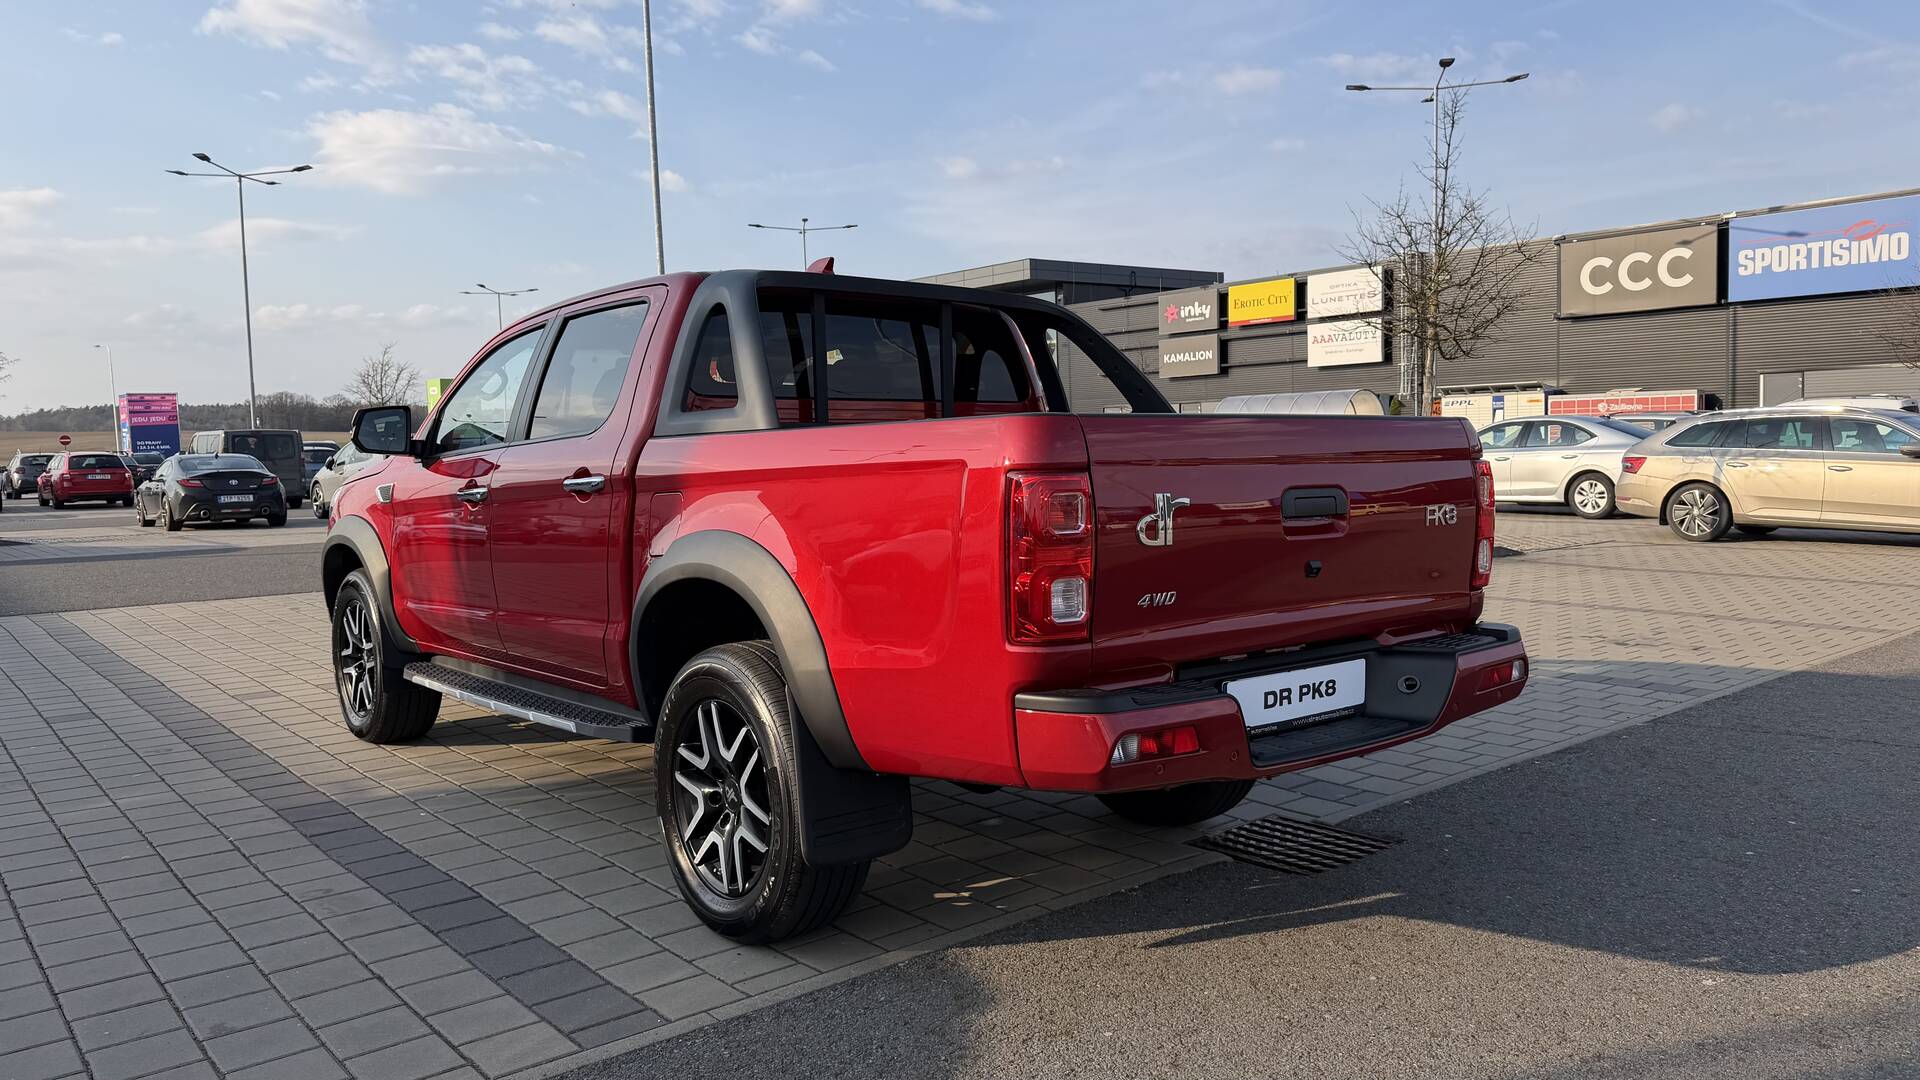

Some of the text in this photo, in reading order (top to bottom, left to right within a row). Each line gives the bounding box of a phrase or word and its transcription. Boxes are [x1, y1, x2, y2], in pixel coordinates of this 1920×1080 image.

[1737, 231, 1910, 276] SPORTISIMO
[1580, 246, 1694, 296] CCC
[1329, 281, 1358, 290] OPTIKA
[1311, 289, 1377, 305] LUNETTES
[1180, 301, 1211, 319] inky
[1311, 330, 1377, 345] AAAVALUTY
[1163, 349, 1213, 364] KAMALION
[1450, 399, 1475, 407] PPL
[131, 415, 166, 424] JEDU JEDU
[1136, 591, 1177, 609] 4WD
[1263, 678, 1337, 711] DR PK8
